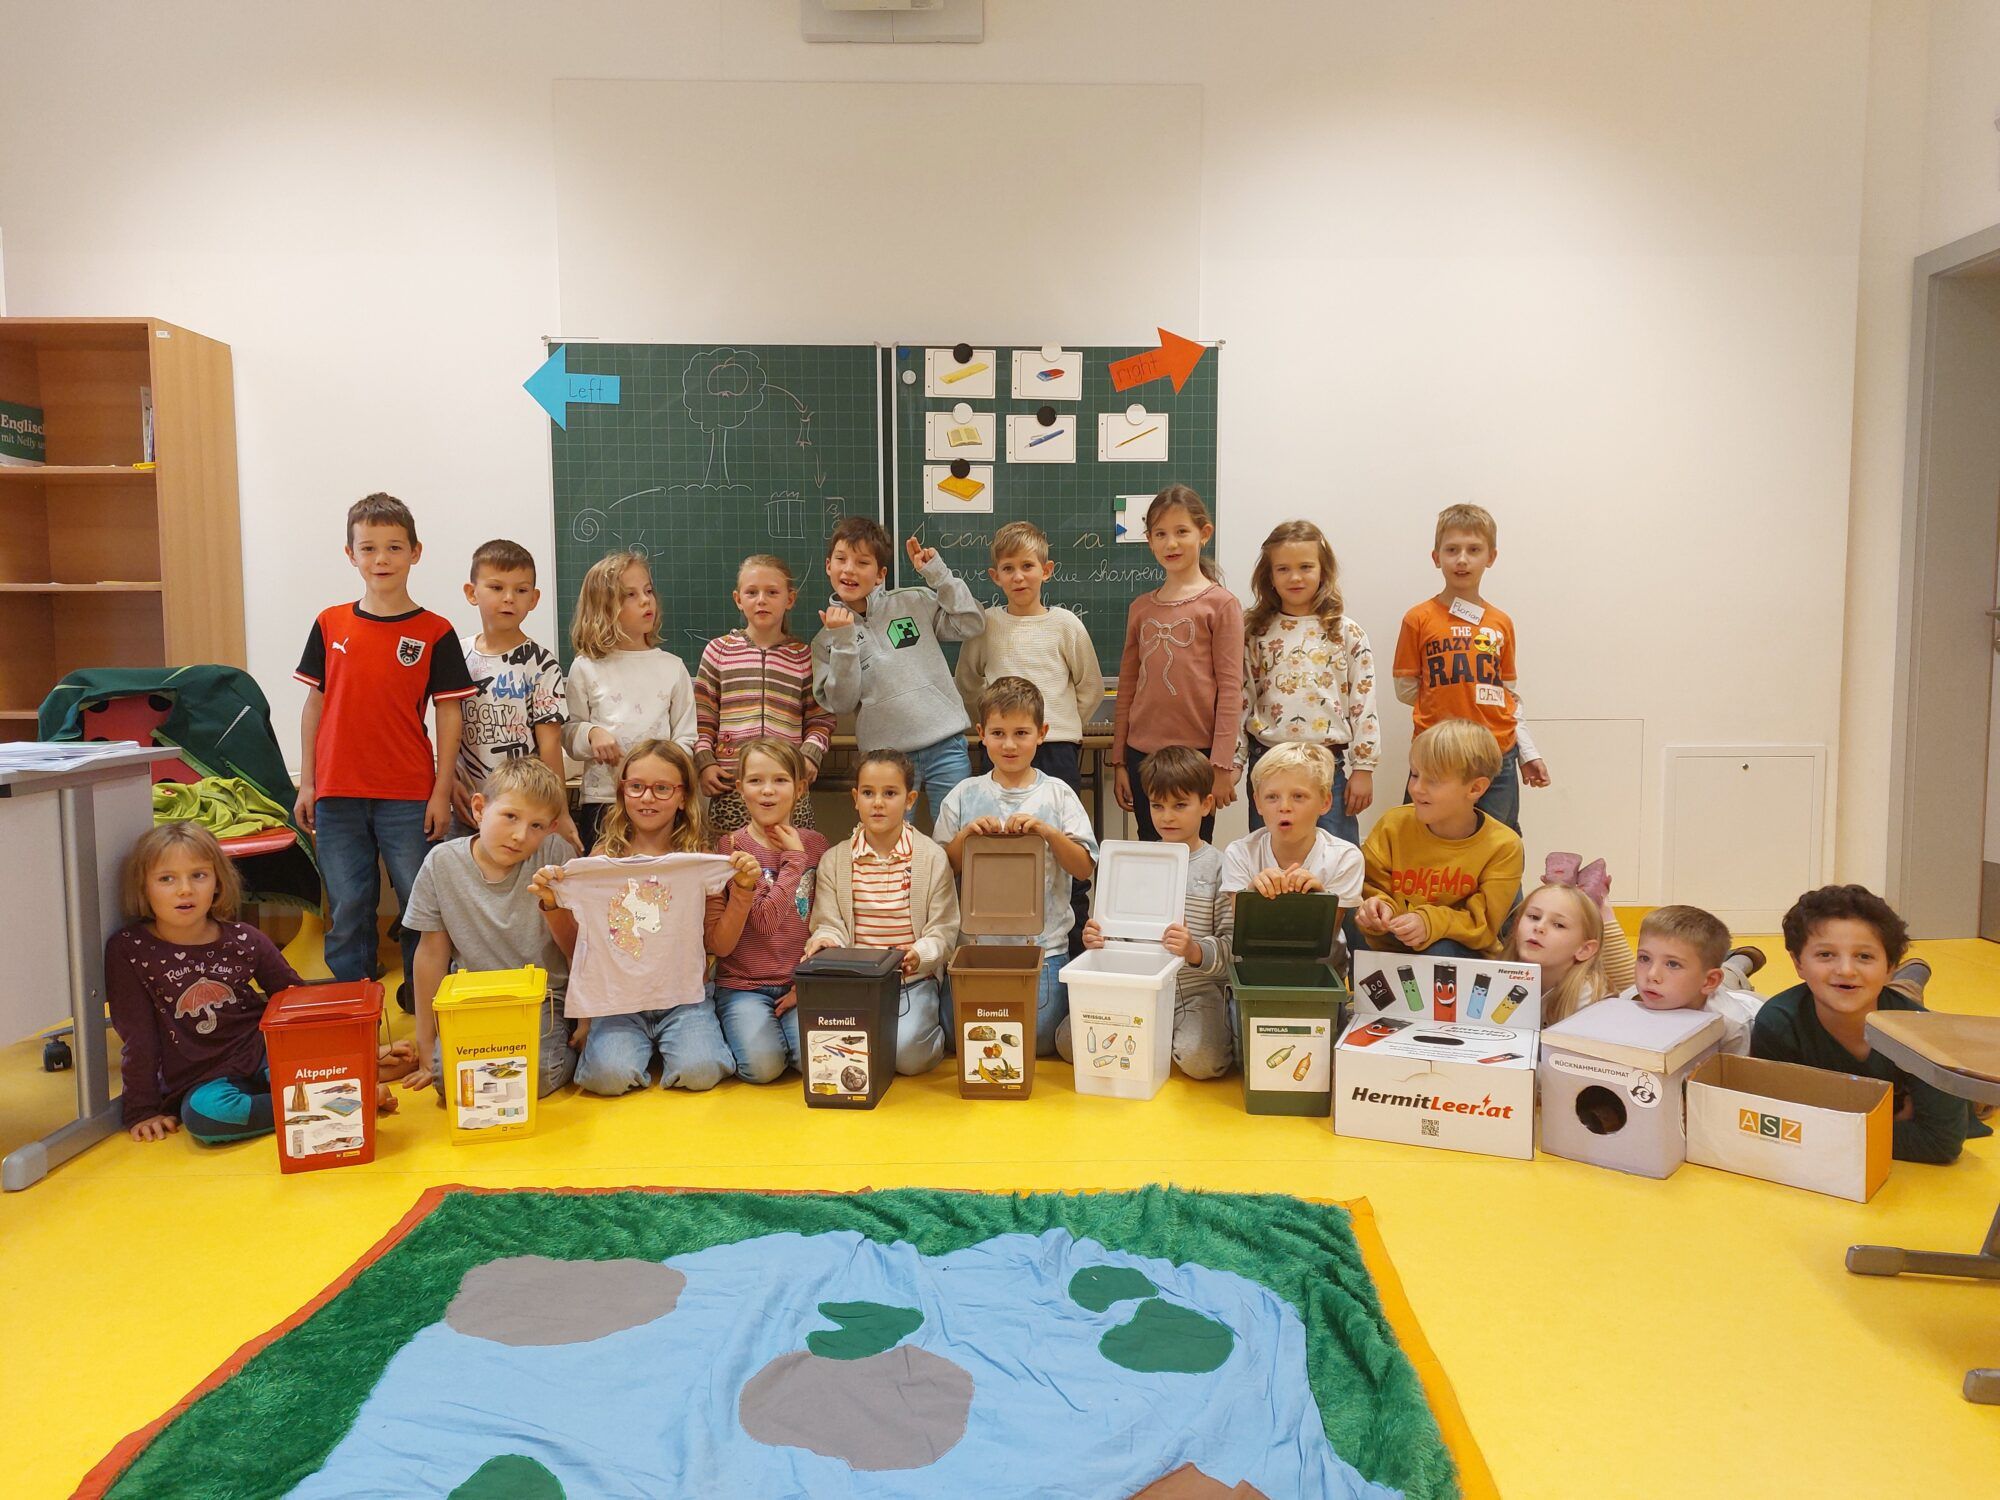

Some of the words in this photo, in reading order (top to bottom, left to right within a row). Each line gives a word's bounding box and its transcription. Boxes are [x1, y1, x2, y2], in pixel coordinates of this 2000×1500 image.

[1116, 354, 1157, 383] right
[569, 377, 604, 402] Left
[1, 433, 15, 443] mit
[17, 435, 37, 449] Nelly
[1051, 561, 1081, 582] lue
[1088, 559, 1167, 592] sharpene
[1452, 601, 1481, 623] Florian
[1450, 626, 1472, 637] THE
[1426, 638, 1472, 656] CRAZY
[479, 703, 517, 727] CITY
[465, 722, 528, 746] DREAMS
[1392, 866, 1478, 902] POKÉMO
[163, 966, 191, 982] Rain
[195, 962, 206, 973] of
[210, 963, 233, 974] Love
[818, 1016, 856, 1026] Restmüll
[977, 1008, 1009, 1017] Biomüll
[456, 1043, 527, 1057] Verpackungen
[295, 1065, 348, 1080] Altpapier
[1554, 1060, 1630, 1078] RÜCKNAHMEAUTOMAT
[1351, 1086, 1514, 1119] HermitLeer.at
[1740, 1111, 1801, 1142] ASZ
